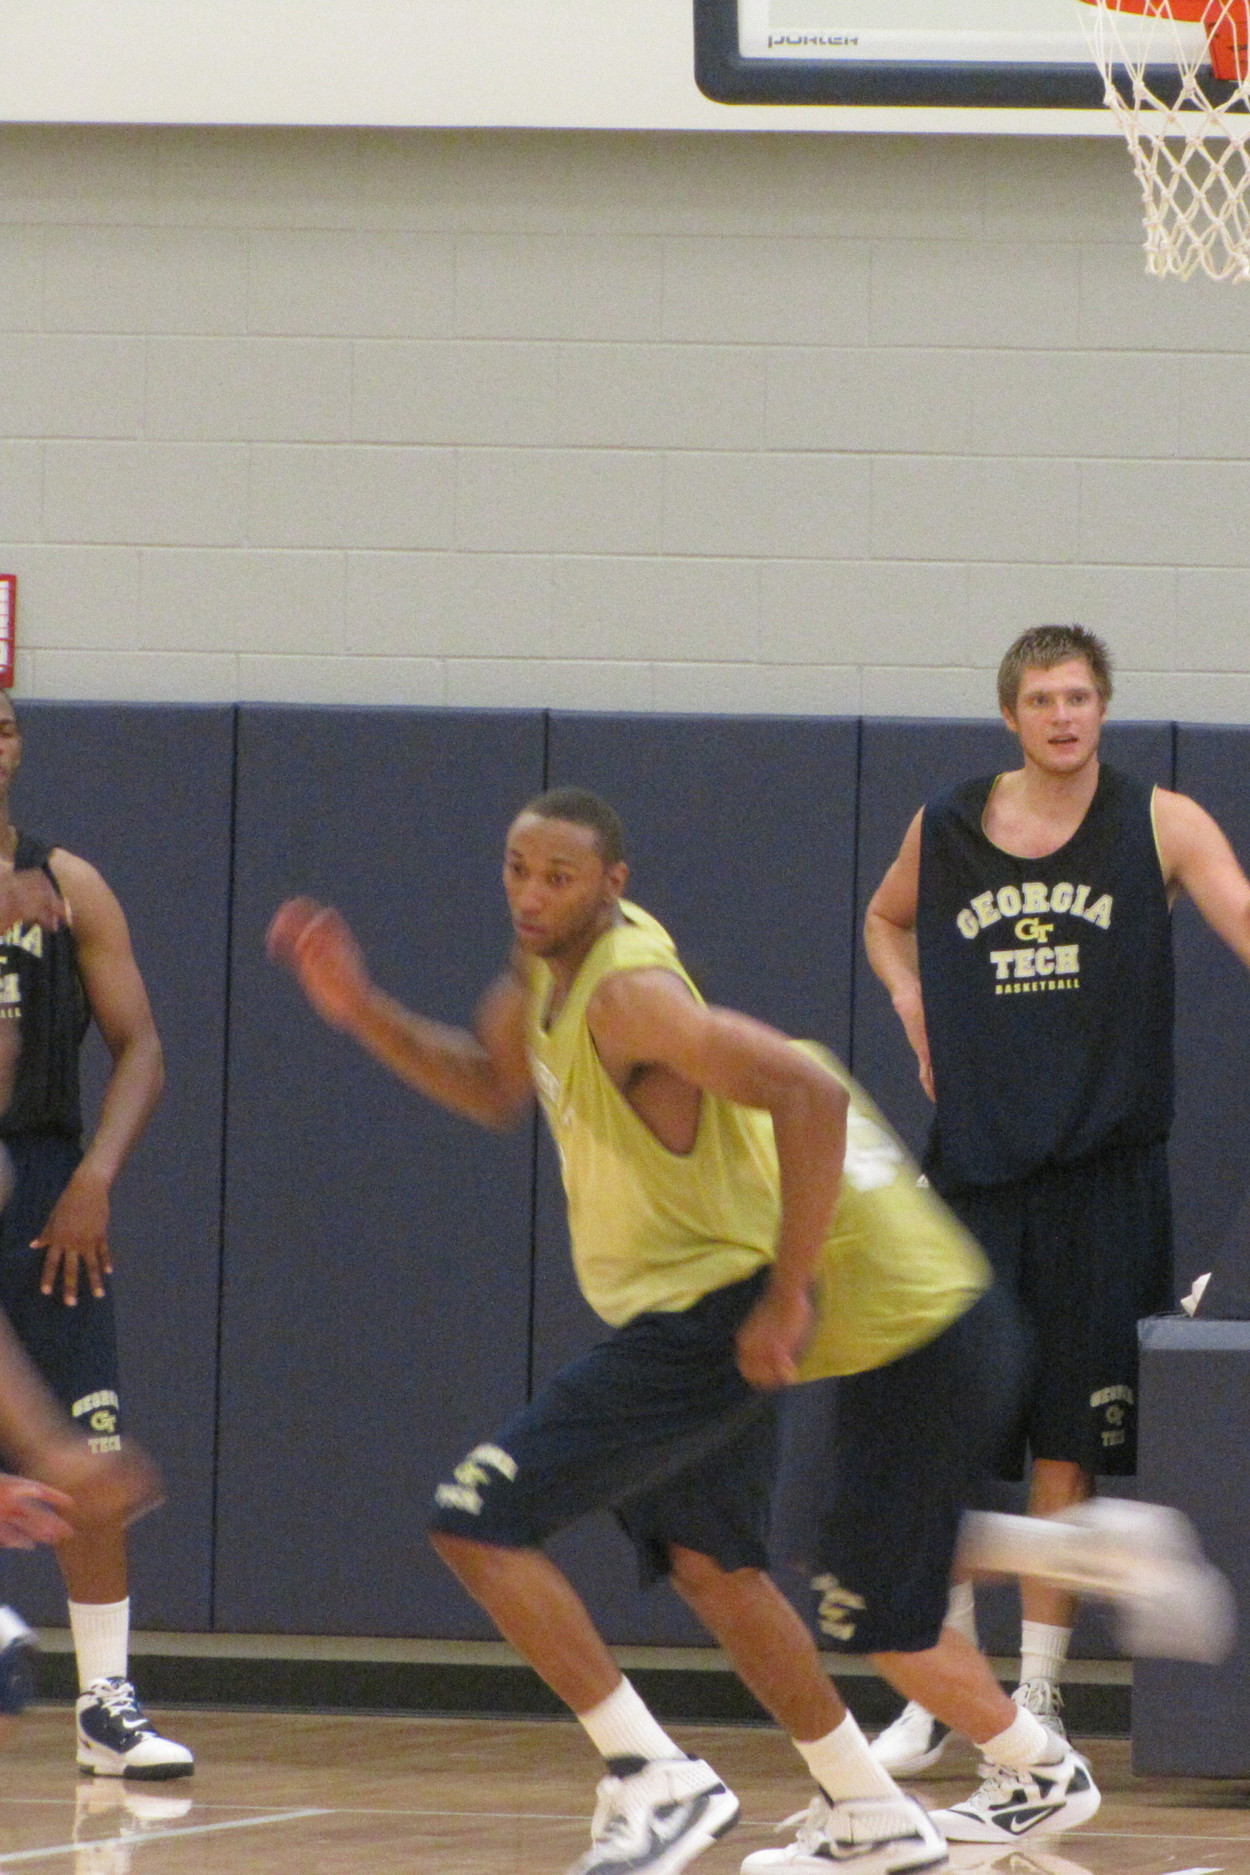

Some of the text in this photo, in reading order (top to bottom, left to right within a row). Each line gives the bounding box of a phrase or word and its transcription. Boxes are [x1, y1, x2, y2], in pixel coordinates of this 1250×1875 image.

[956, 881, 1114, 940] GEORGIA
[1014, 917, 1055, 944] GT
[990, 944, 1081, 980] TECH
[995, 978, 1081, 995] BASKETBALL
